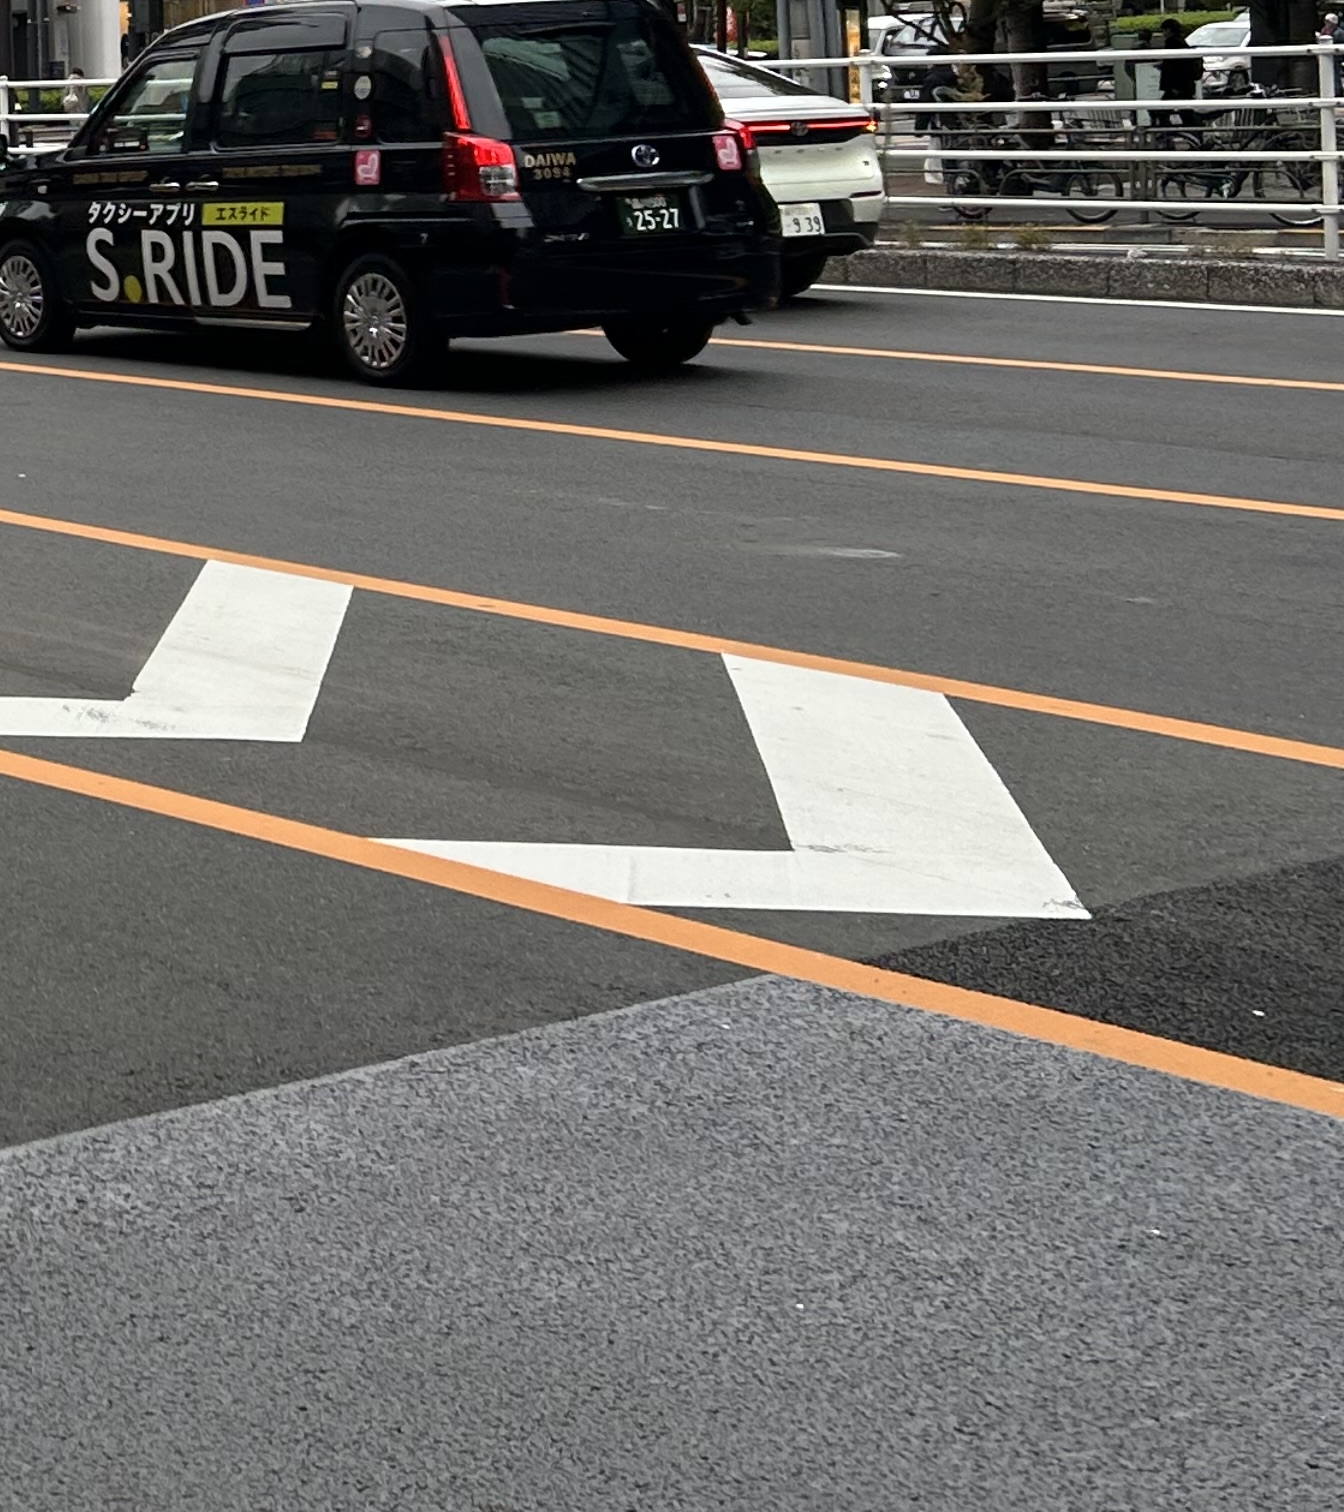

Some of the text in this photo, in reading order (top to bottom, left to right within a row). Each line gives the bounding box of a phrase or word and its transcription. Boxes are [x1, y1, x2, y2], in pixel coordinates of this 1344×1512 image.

[524, 152, 577, 168] DAIWA
[88, 201, 271, 226] タクシーアプリ エスライド
[633, 208, 679, 230] 25-27
[86, 227, 292, 308] S.RIDE
